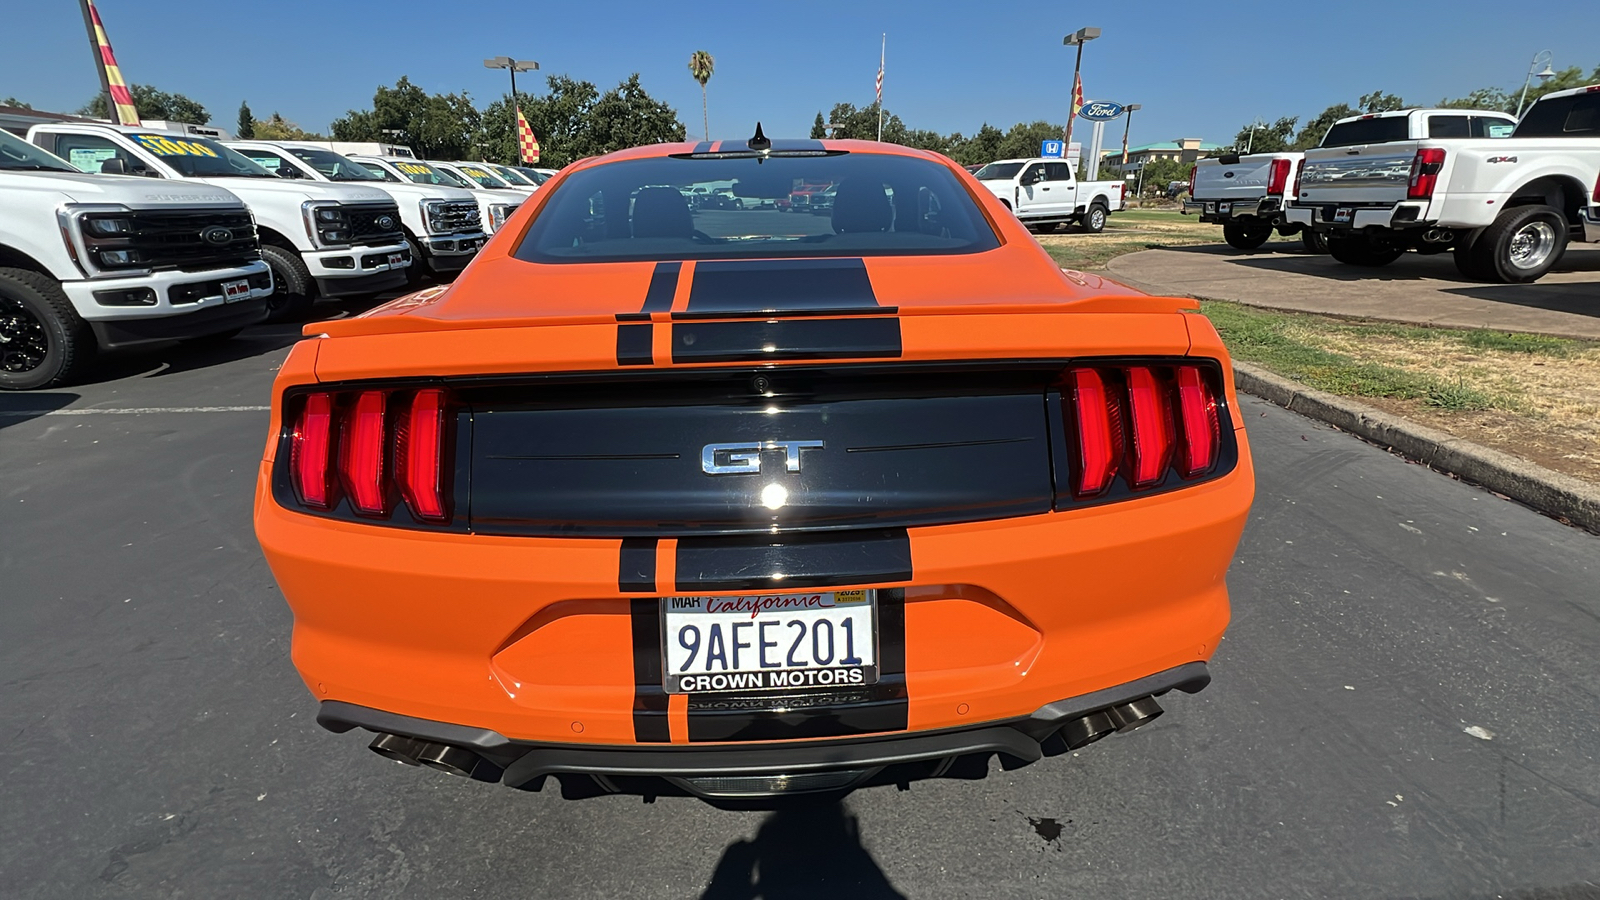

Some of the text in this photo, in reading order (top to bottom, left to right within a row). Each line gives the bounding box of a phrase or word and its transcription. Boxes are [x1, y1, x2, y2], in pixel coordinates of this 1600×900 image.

[1087, 103, 1117, 116] Ford
[702, 439, 826, 477] GT
[672, 597, 700, 610] MAR
[706, 594, 835, 619] California
[678, 617, 863, 672] 9AFE201
[680, 668, 864, 691] CROWN MOTORS
